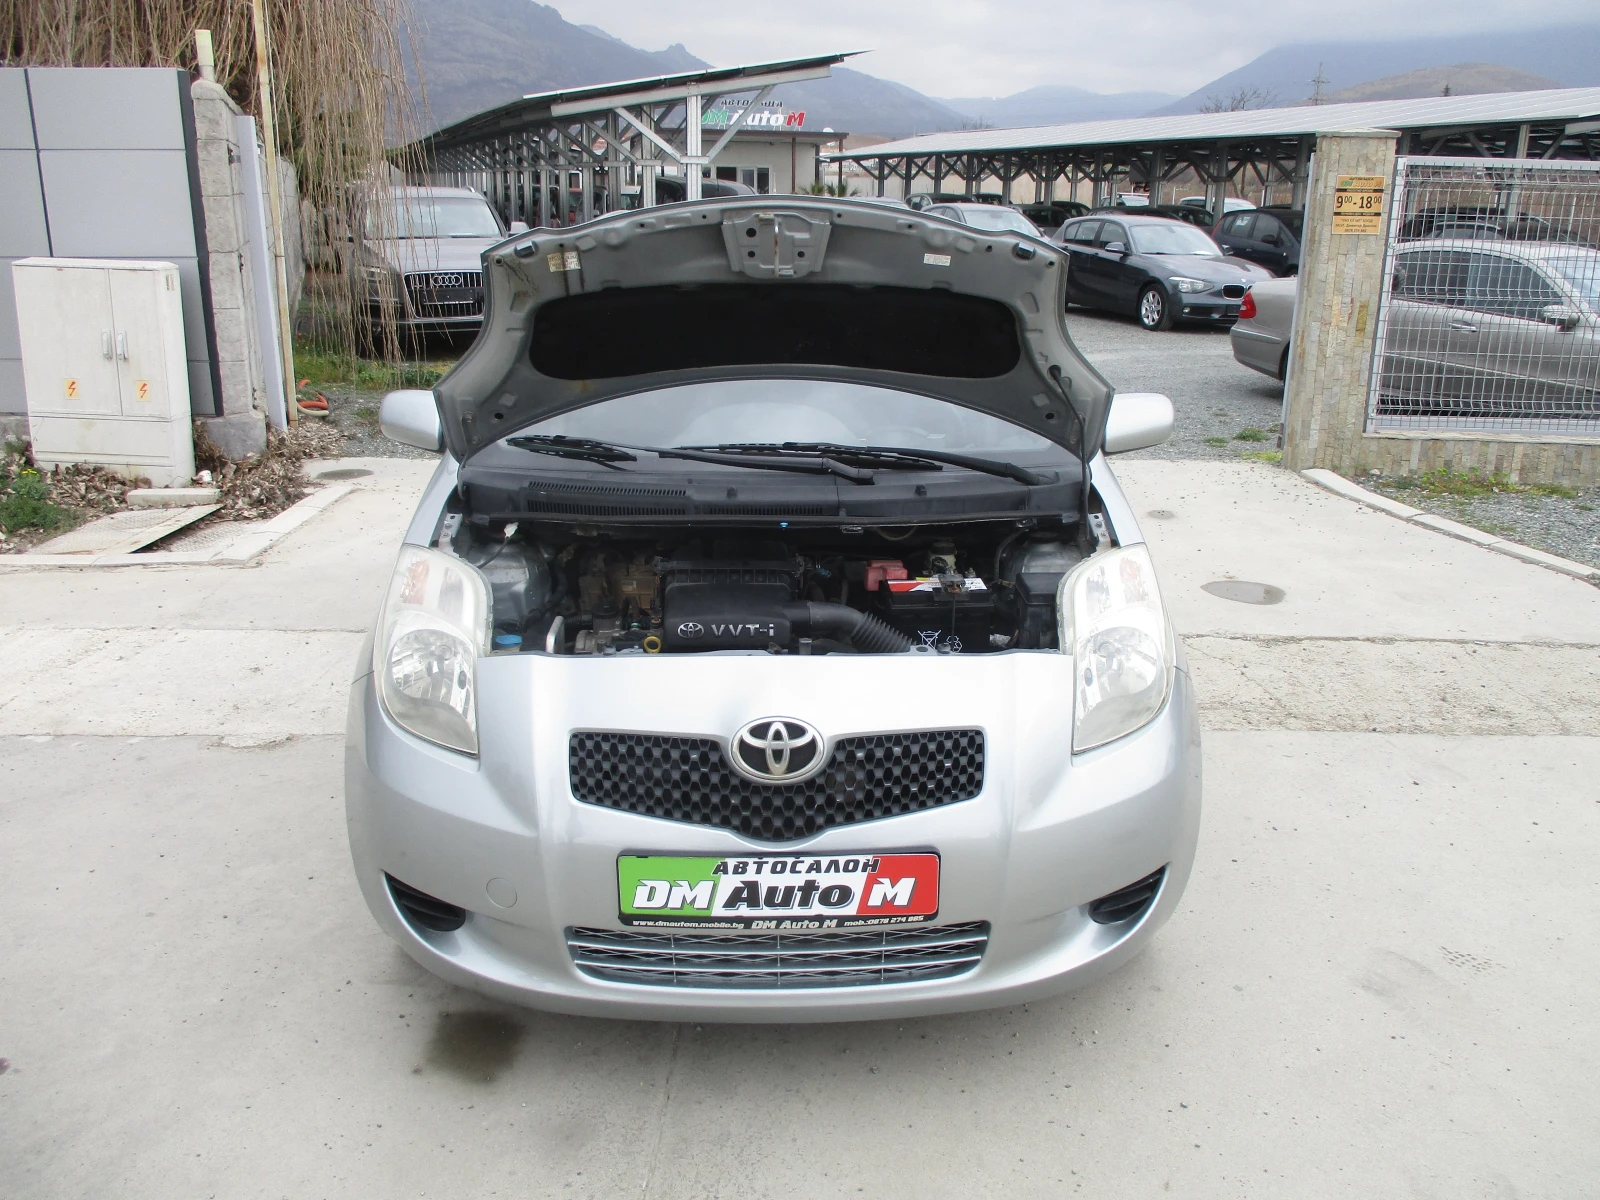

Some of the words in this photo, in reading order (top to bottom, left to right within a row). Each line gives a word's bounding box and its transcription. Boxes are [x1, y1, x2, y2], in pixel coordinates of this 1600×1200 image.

[786, 111, 805, 127] M
[711, 623, 774, 636] VVT-i
[712, 858, 880, 876] АВТОСАЛОН
[632, 879, 717, 910] DM
[721, 879, 855, 910] Auto
[866, 877, 917, 908] M
[751, 920, 777, 929] DM
[779, 919, 820, 929] Auto
[822, 918, 838, 928] M
